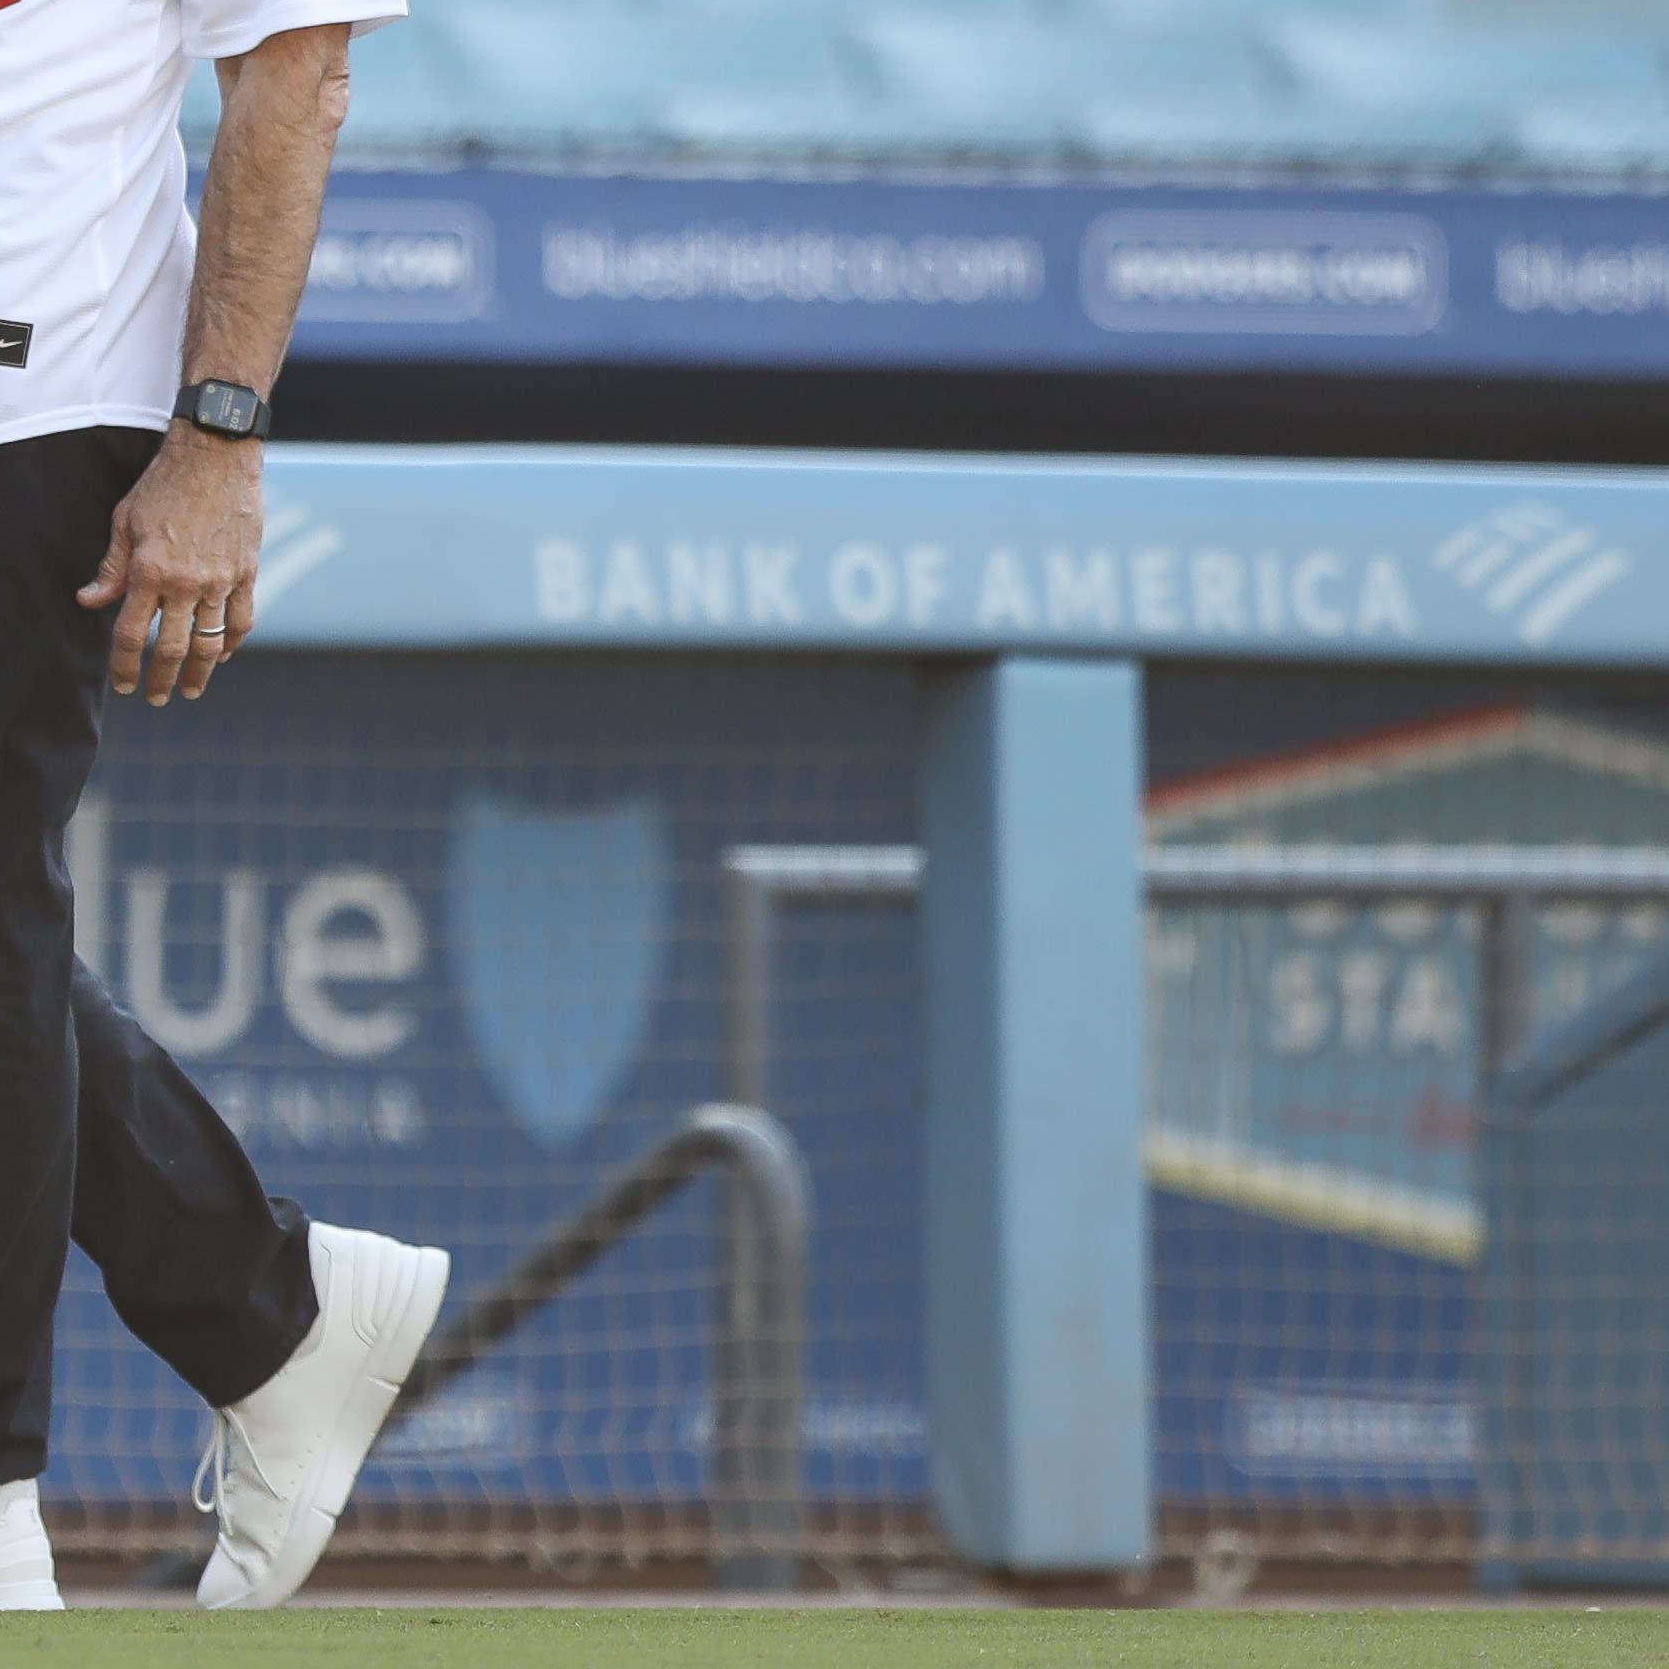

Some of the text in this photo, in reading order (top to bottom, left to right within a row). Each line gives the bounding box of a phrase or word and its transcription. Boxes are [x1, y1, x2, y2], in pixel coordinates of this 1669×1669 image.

[534, 538, 1416, 639] BANK OF AMERICA
[66, 787, 429, 1060] lue
